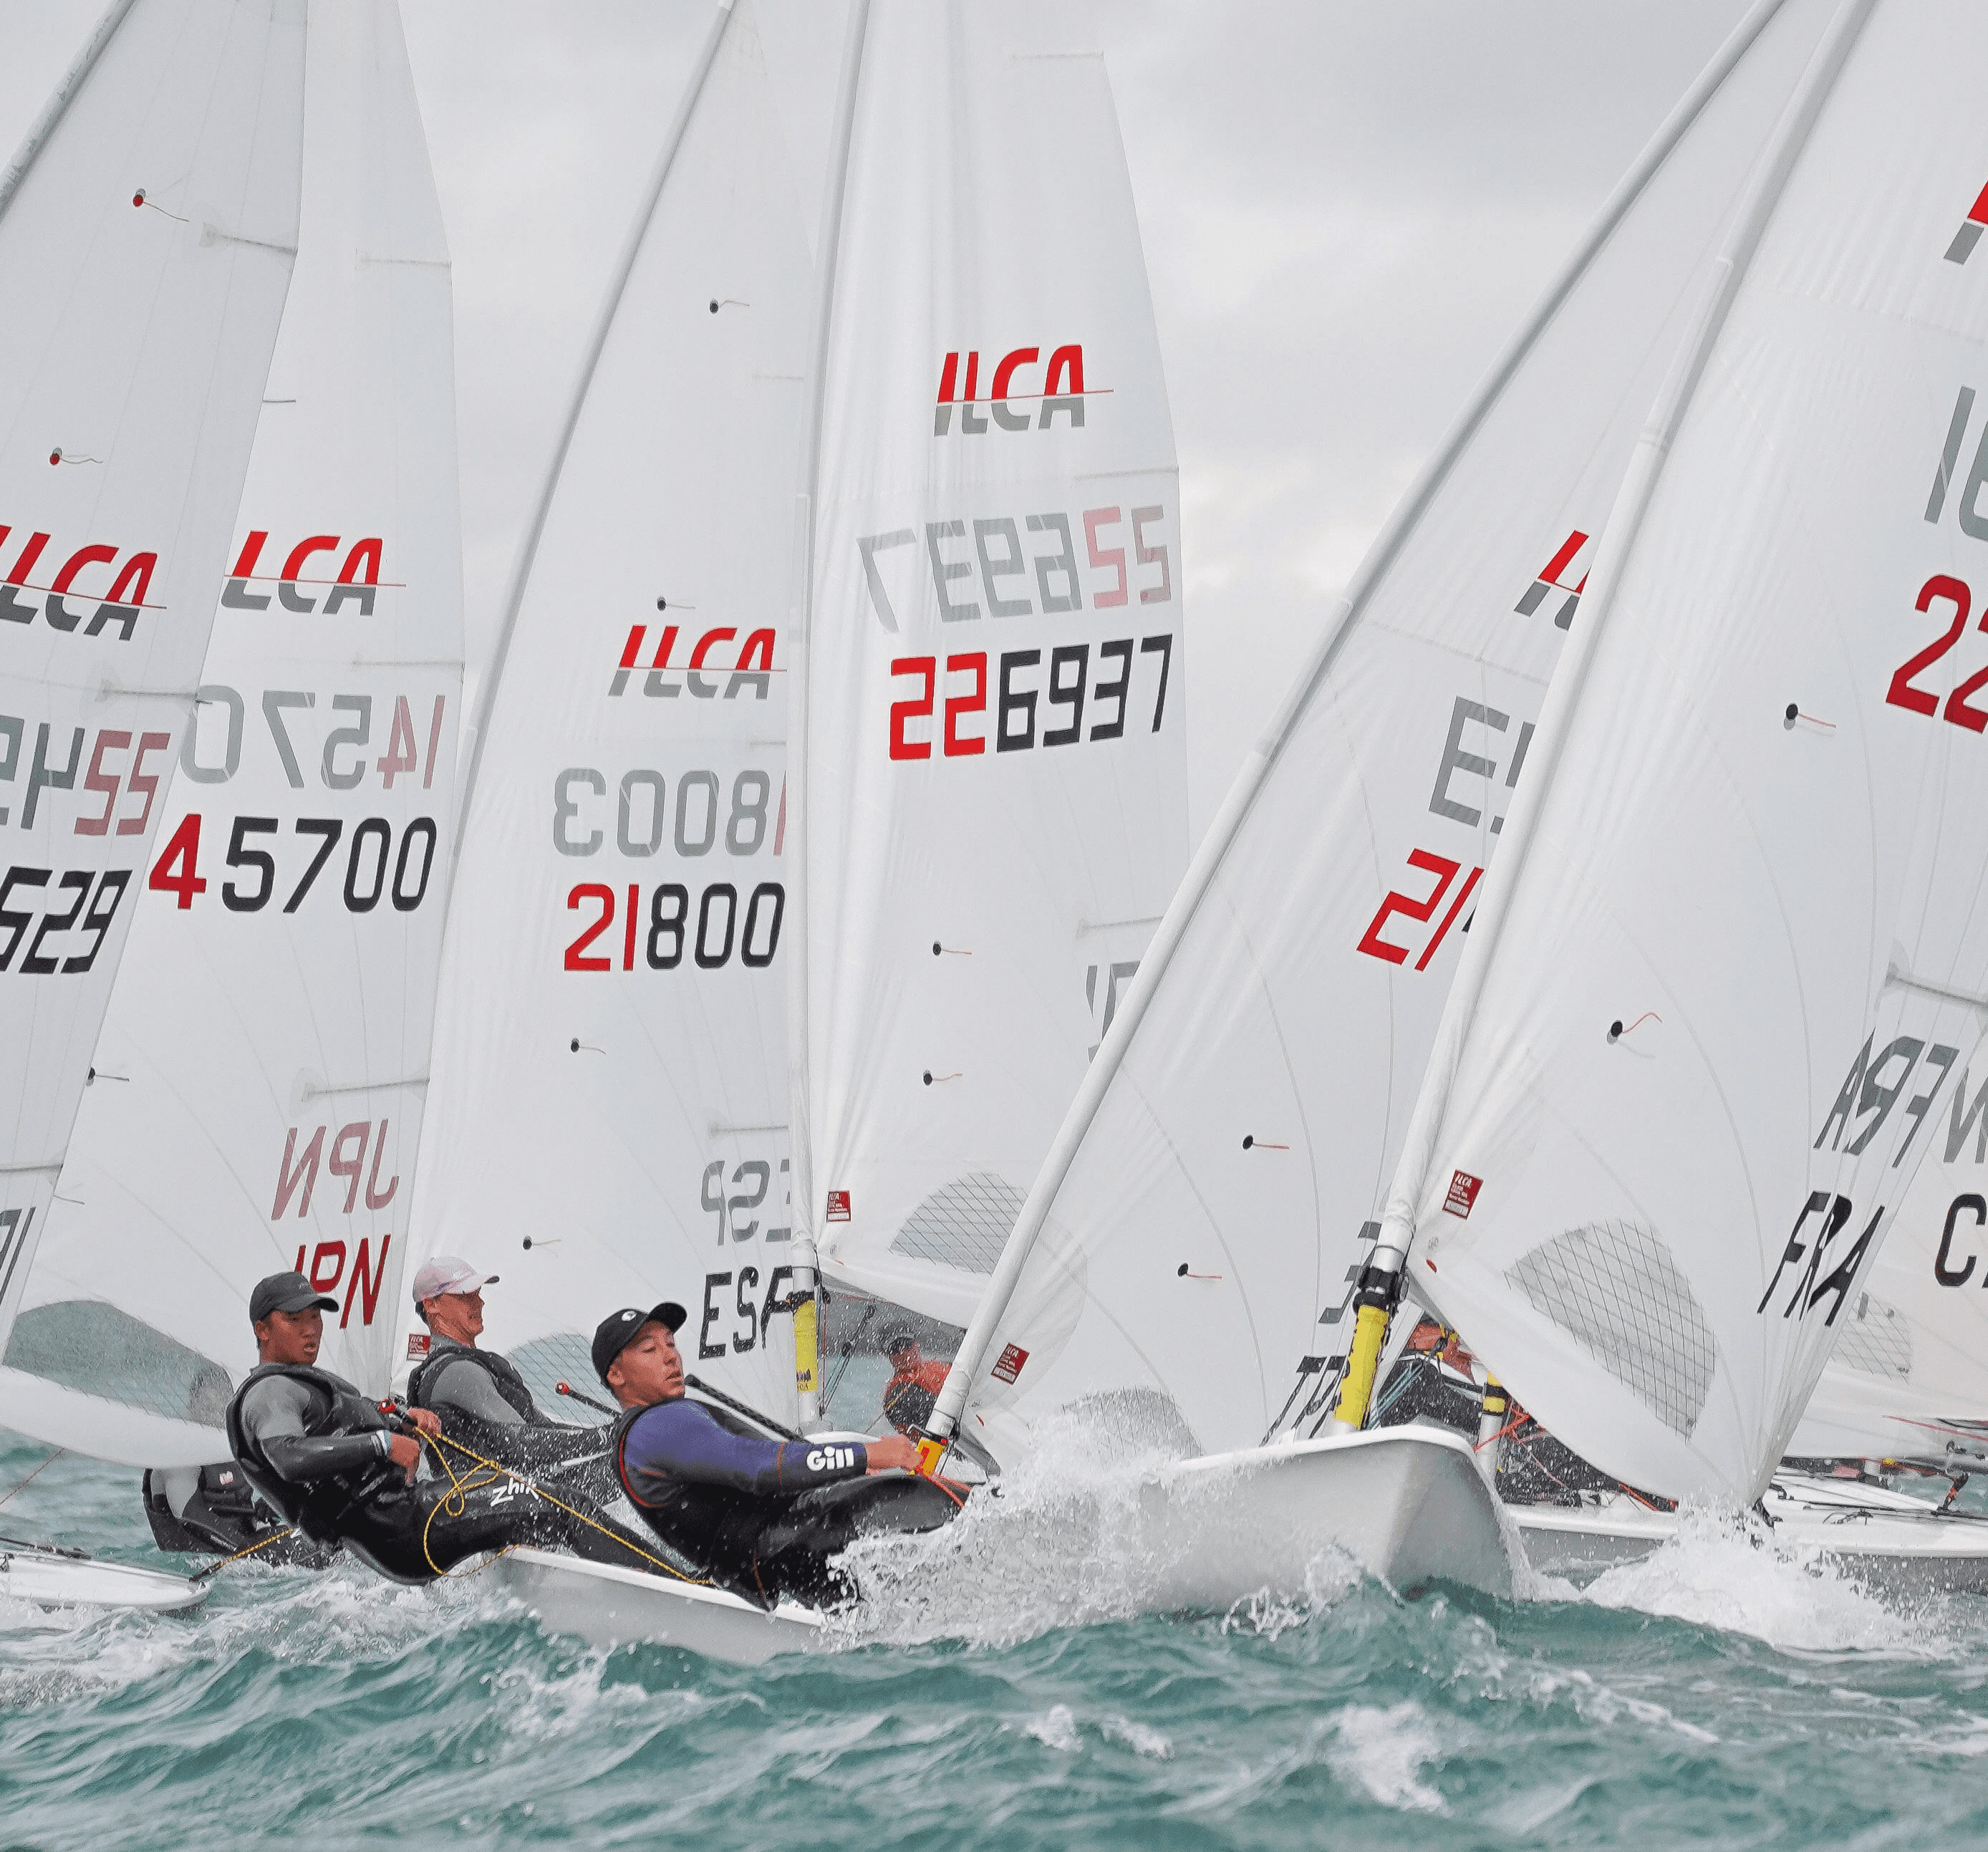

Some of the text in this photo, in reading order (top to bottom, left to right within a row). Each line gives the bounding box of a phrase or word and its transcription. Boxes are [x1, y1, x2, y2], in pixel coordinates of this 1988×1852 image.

[934, 344, 1086, 437] ILCA
[0, 524, 157, 642] LCA
[608, 624, 776, 700] ILCA
[889, 633, 1174, 761] 226937
[148, 813, 438, 914] 45700
[564, 881, 786, 972] 21800
[1757, 1190, 1886, 1328] FRA
[806, 1446, 854, 1472] Gill
